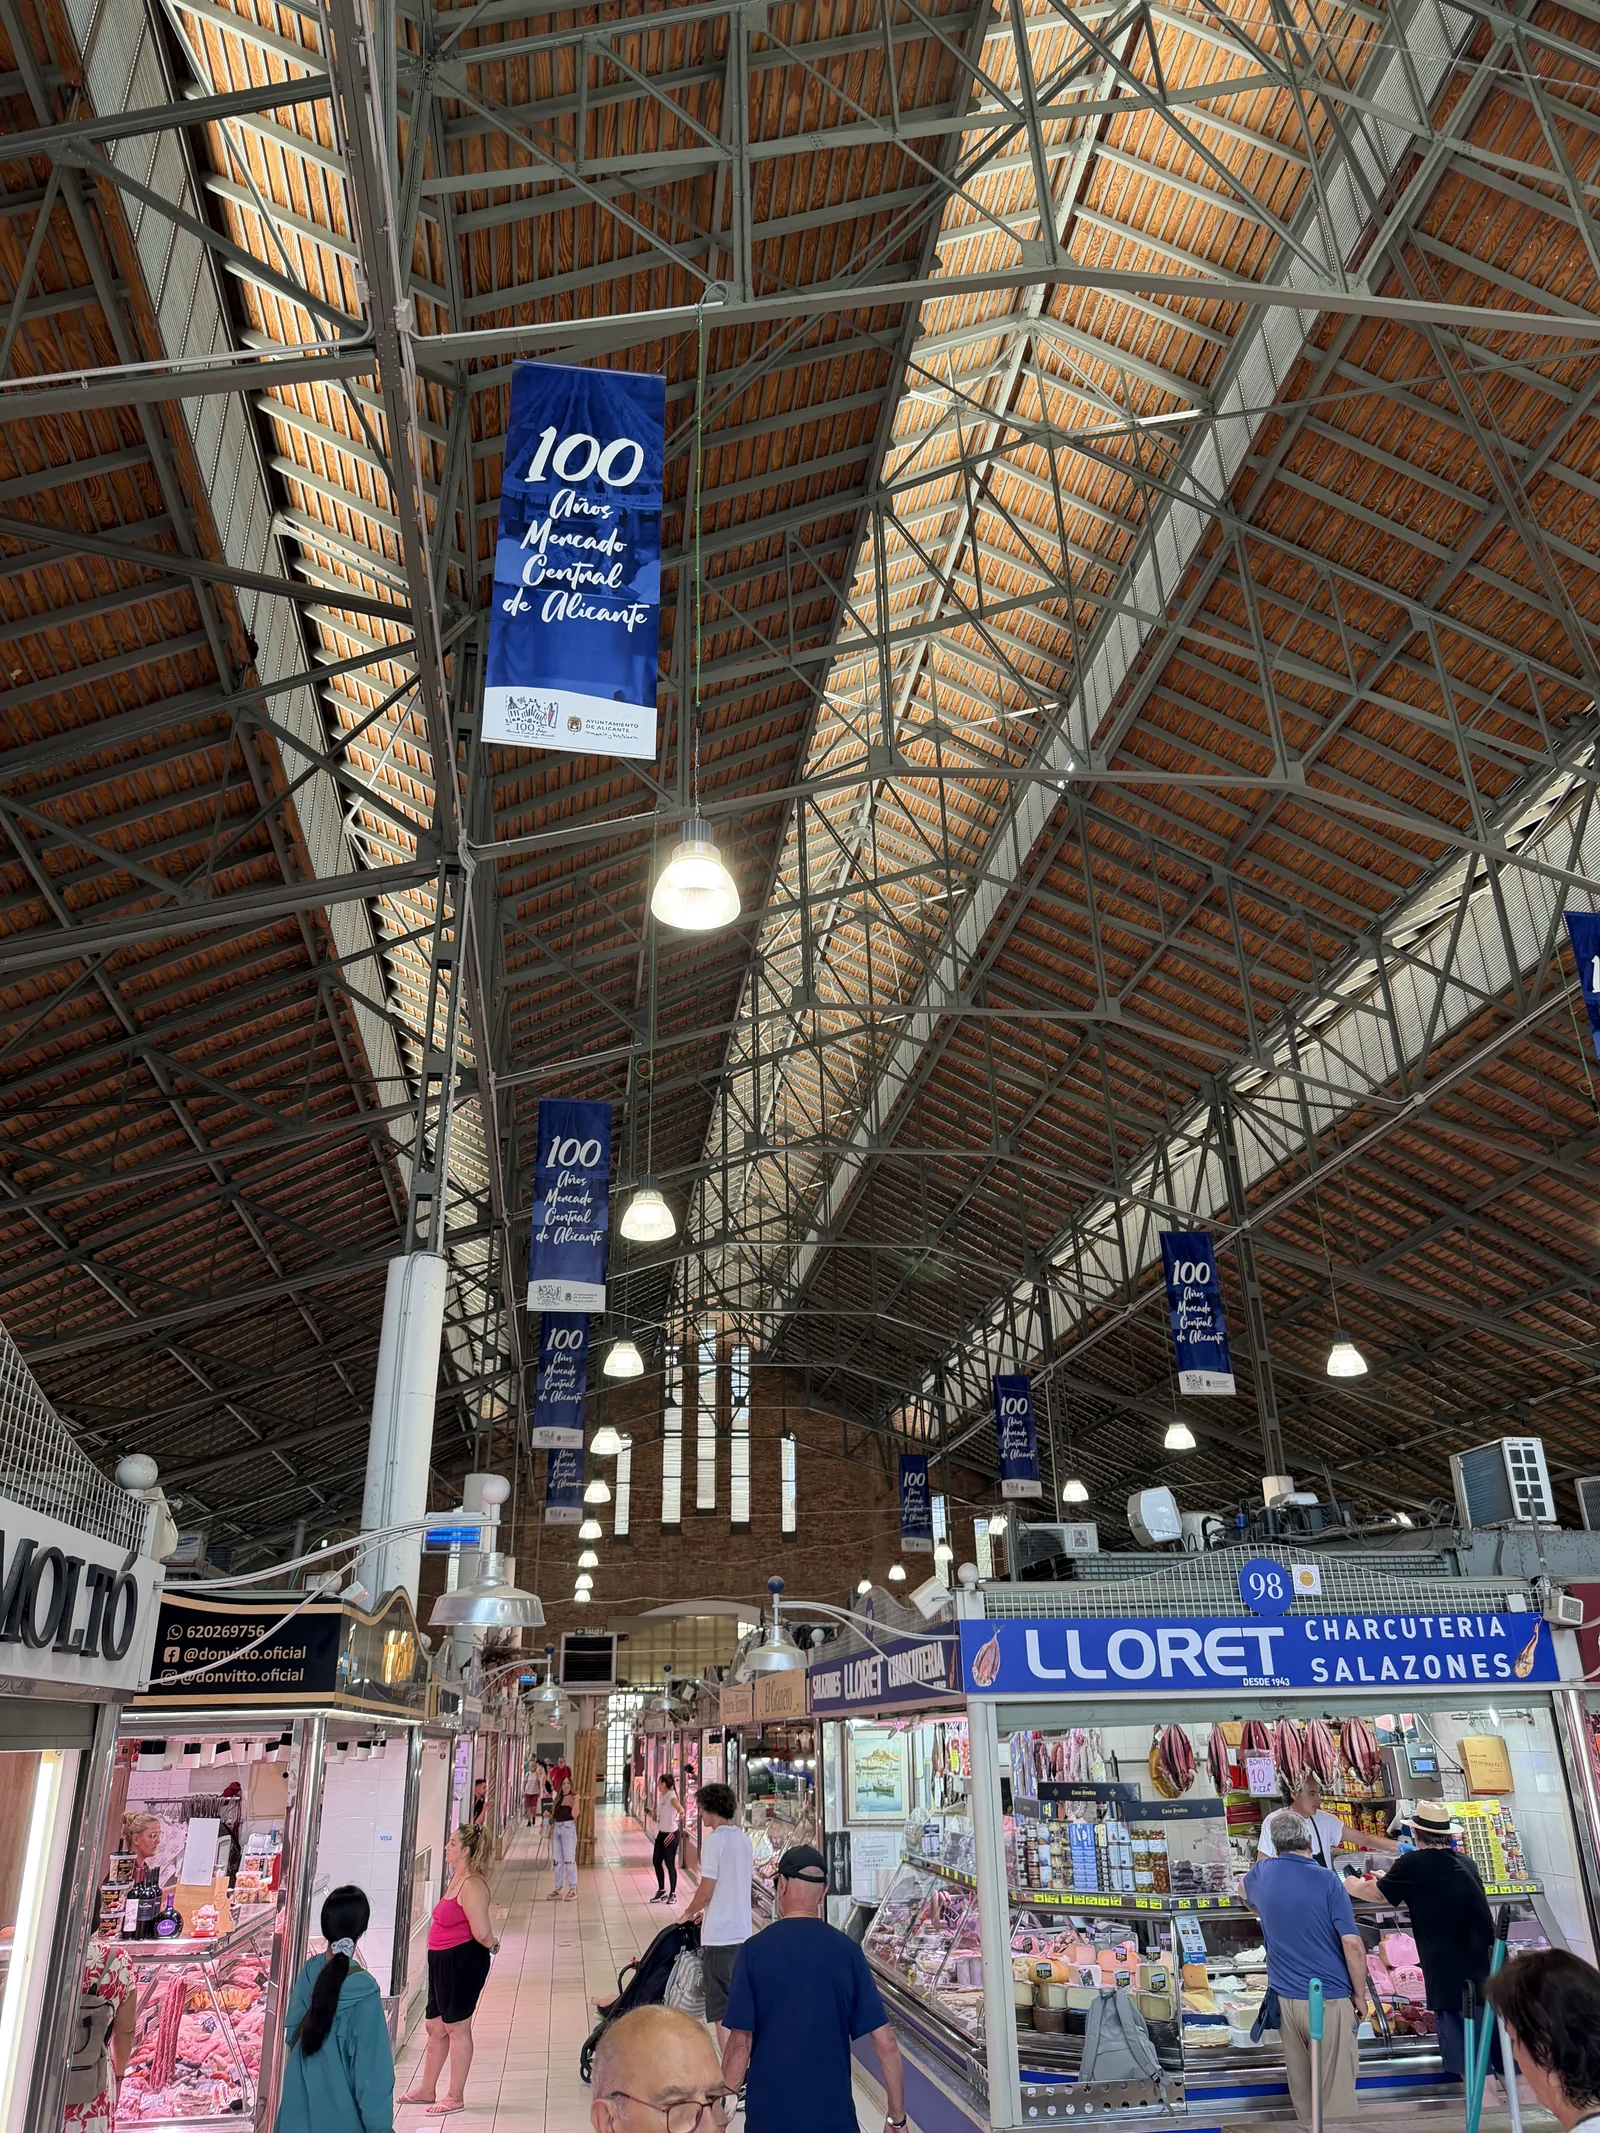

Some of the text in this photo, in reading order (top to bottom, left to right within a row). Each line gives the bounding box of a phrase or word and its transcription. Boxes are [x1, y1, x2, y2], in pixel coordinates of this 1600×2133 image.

[525, 426, 645, 487] 100
[549, 488, 613, 521] Años
[520, 519, 627, 555] Mercado
[522, 554, 623, 590] Central
[502, 587, 650, 633] de Alicante
[515, 722, 534, 732] 100
[586, 719, 639, 728] AYUNTAMIENTO
[545, 1135, 602, 1168] 100
[556, 1170, 587, 1188] Años
[544, 1188, 593, 1207] Mercado
[544, 1207, 591, 1226] Central
[536, 1227, 603, 1246] de Alicante
[1173, 1259, 1210, 1285] 100
[1183, 1286, 1205, 1300] Años
[1177, 1301, 1211, 1316] Mercado
[1180, 1315, 1213, 1330] Central
[546, 1328, 583, 1350] 100
[1176, 1330, 1224, 1345] de Alicante
[1000, 1396, 1028, 1416] 100
[903, 1471, 926, 1487] 100
[1249, 1573, 1284, 1600] 98
[187, 1625, 265, 1638] 620269756
[1304, 1617, 1506, 1641] CHARCUTERIA
[1025, 1627, 1284, 1679] LLORET
[181, 1668, 304, 1685] @donvitto.oficial
[844, 1655, 883, 1700] LLORET
[1311, 1653, 1511, 1683] SALAZONES
[1243, 1677, 1290, 1686] DESDE 1943
[1251, 1768, 1264, 1783] 10
